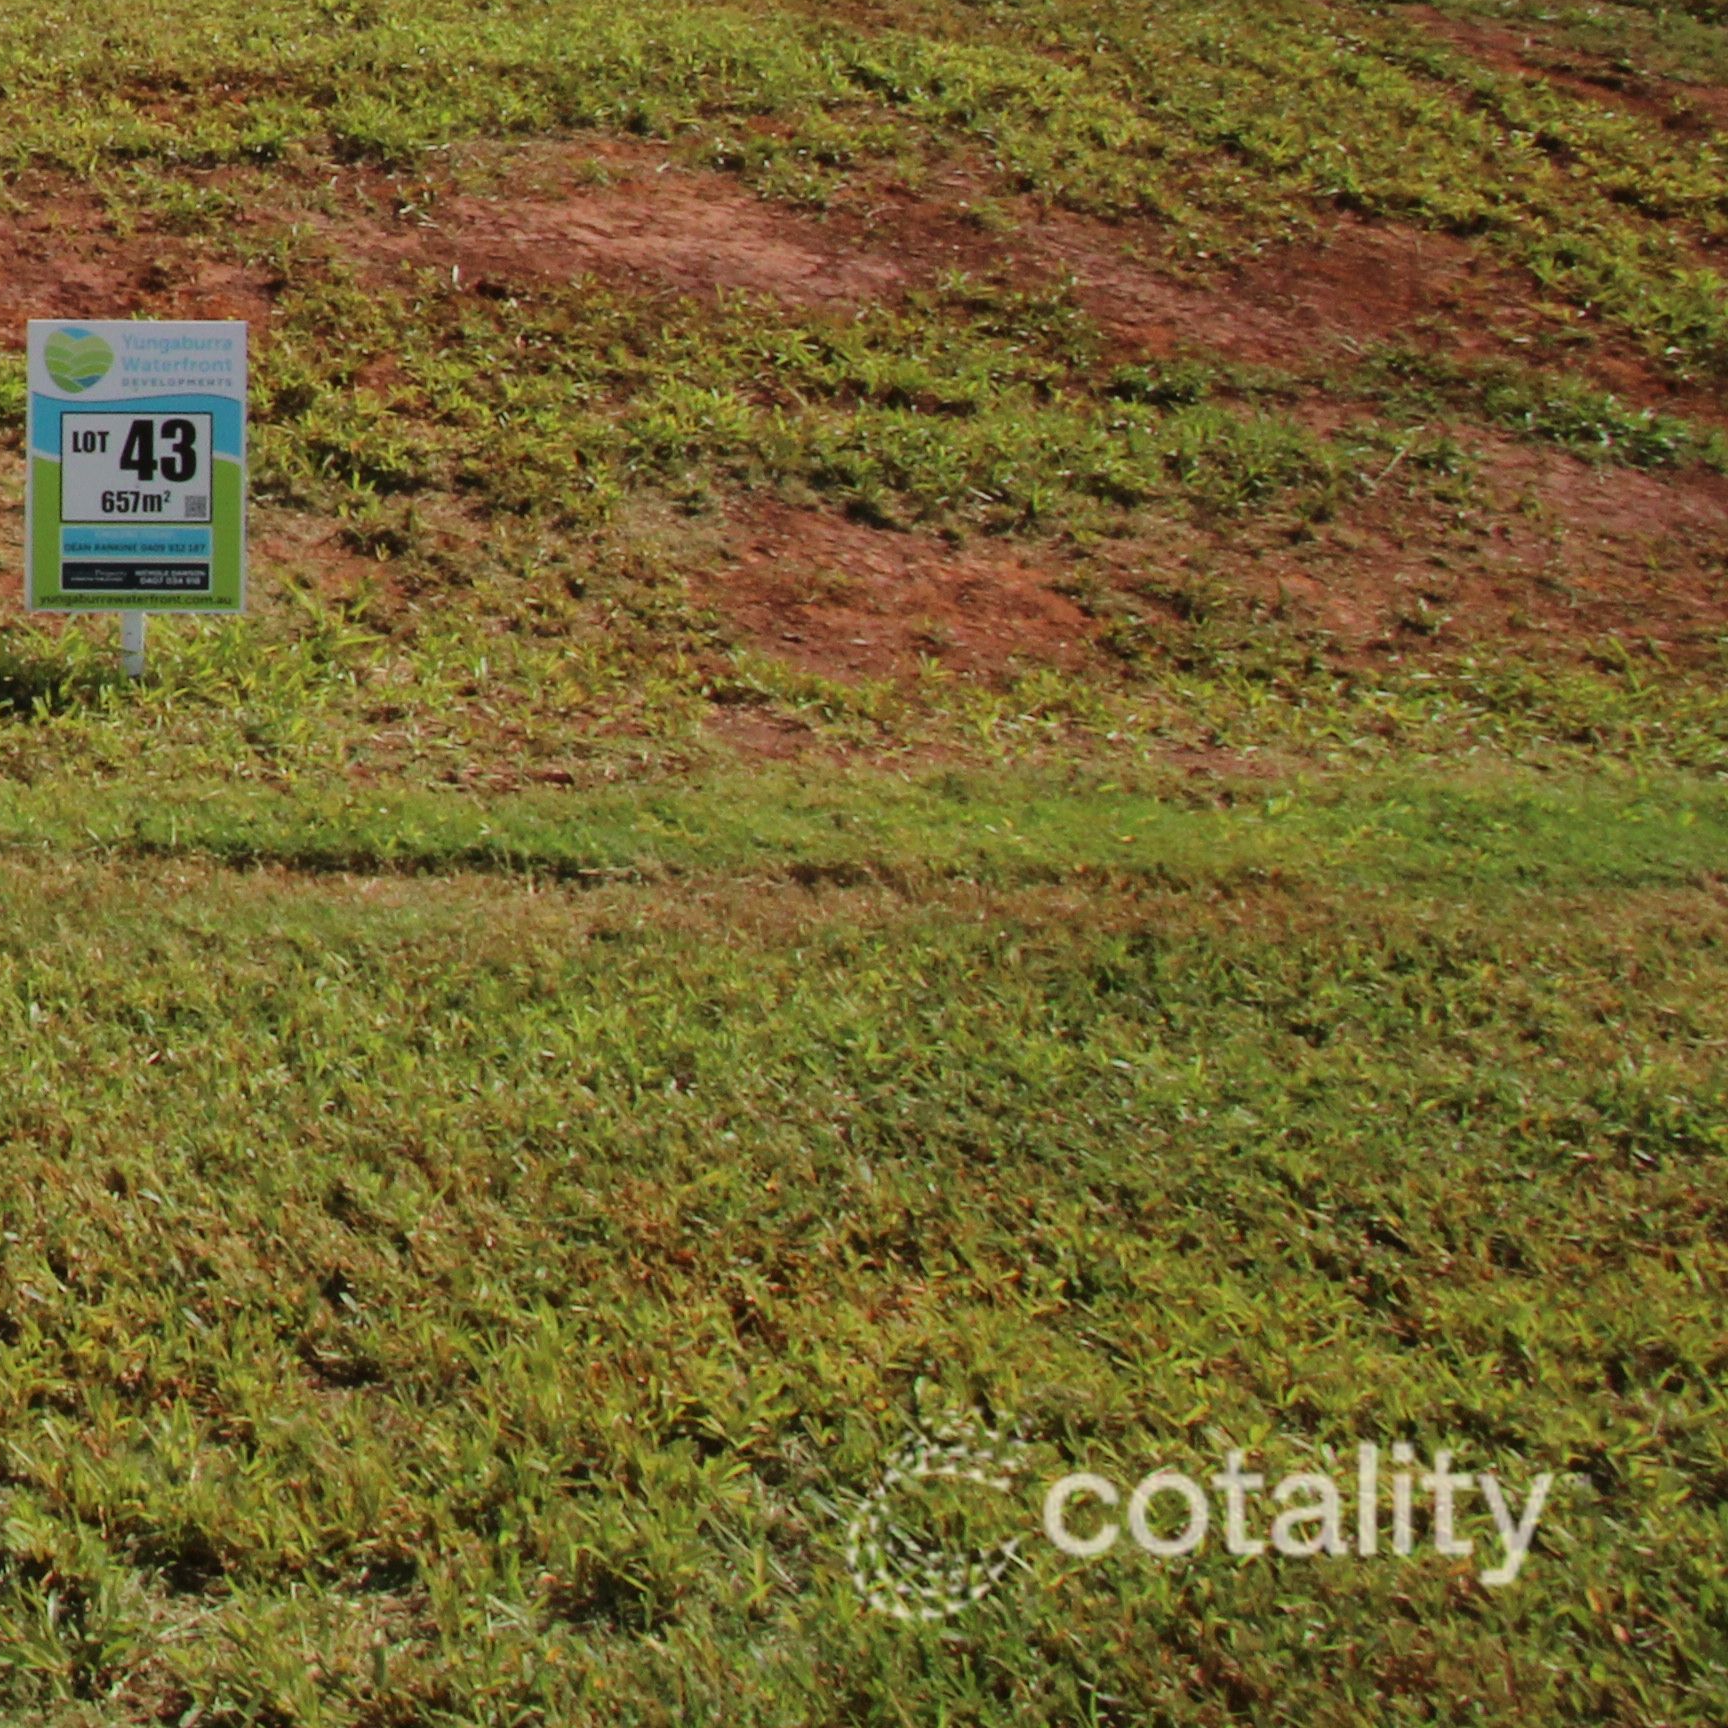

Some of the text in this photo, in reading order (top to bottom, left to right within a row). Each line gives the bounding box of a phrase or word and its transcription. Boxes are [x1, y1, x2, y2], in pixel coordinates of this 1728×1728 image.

[123, 334, 232, 353] Yungaburra
[123, 357, 232, 372] Waterfront
[123, 378, 231, 387] DEVELOPMENTS
[73, 418, 196, 482] LOT 43
[40, 594, 233, 606] yungaburrawaterfront.com.au
